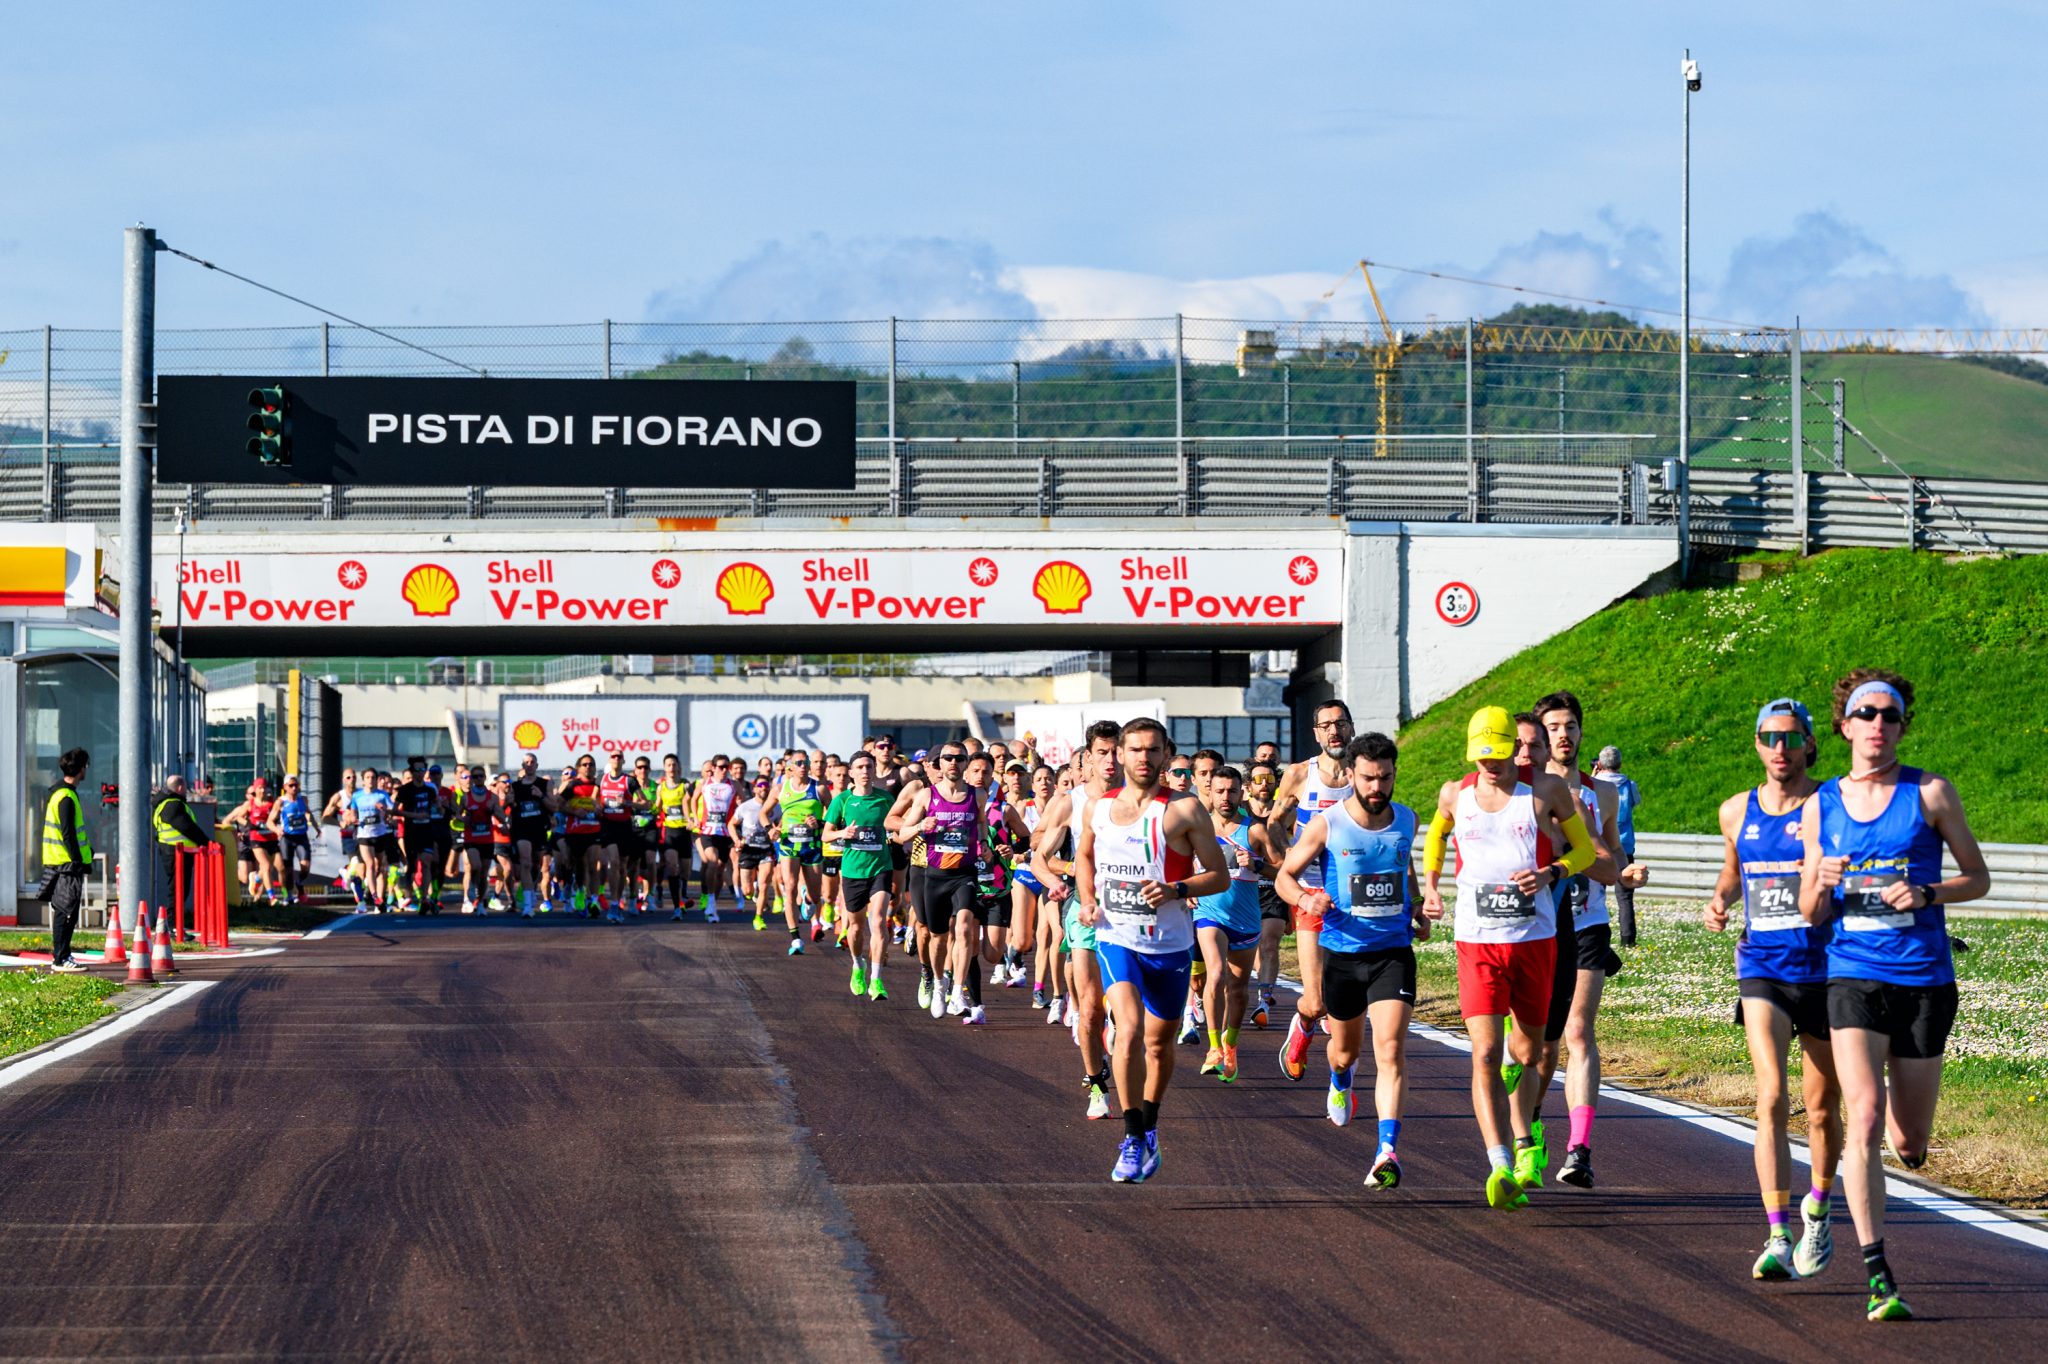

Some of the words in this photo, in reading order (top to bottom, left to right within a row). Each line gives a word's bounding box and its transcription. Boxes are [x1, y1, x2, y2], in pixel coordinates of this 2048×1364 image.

[368, 413, 513, 444] PISTA
[527, 415, 574, 445] DI
[591, 415, 822, 447] FIORANO
[176, 560, 241, 584] Shell
[487, 559, 553, 584] Shell
[803, 558, 869, 582] Shell
[1121, 556, 1188, 581] Shell
[180, 590, 355, 621] V-Power
[491, 589, 668, 621] V-Power
[805, 588, 985, 619] V-Power
[1122, 586, 1305, 618] V-Power
[562, 718, 599, 731] Shell
[563, 734, 662, 752] V-Power
[943, 832, 962, 841] 223
[1366, 883, 1394, 897] 690
[1488, 894, 1520, 908] 764
[1759, 888, 1795, 907] 274
